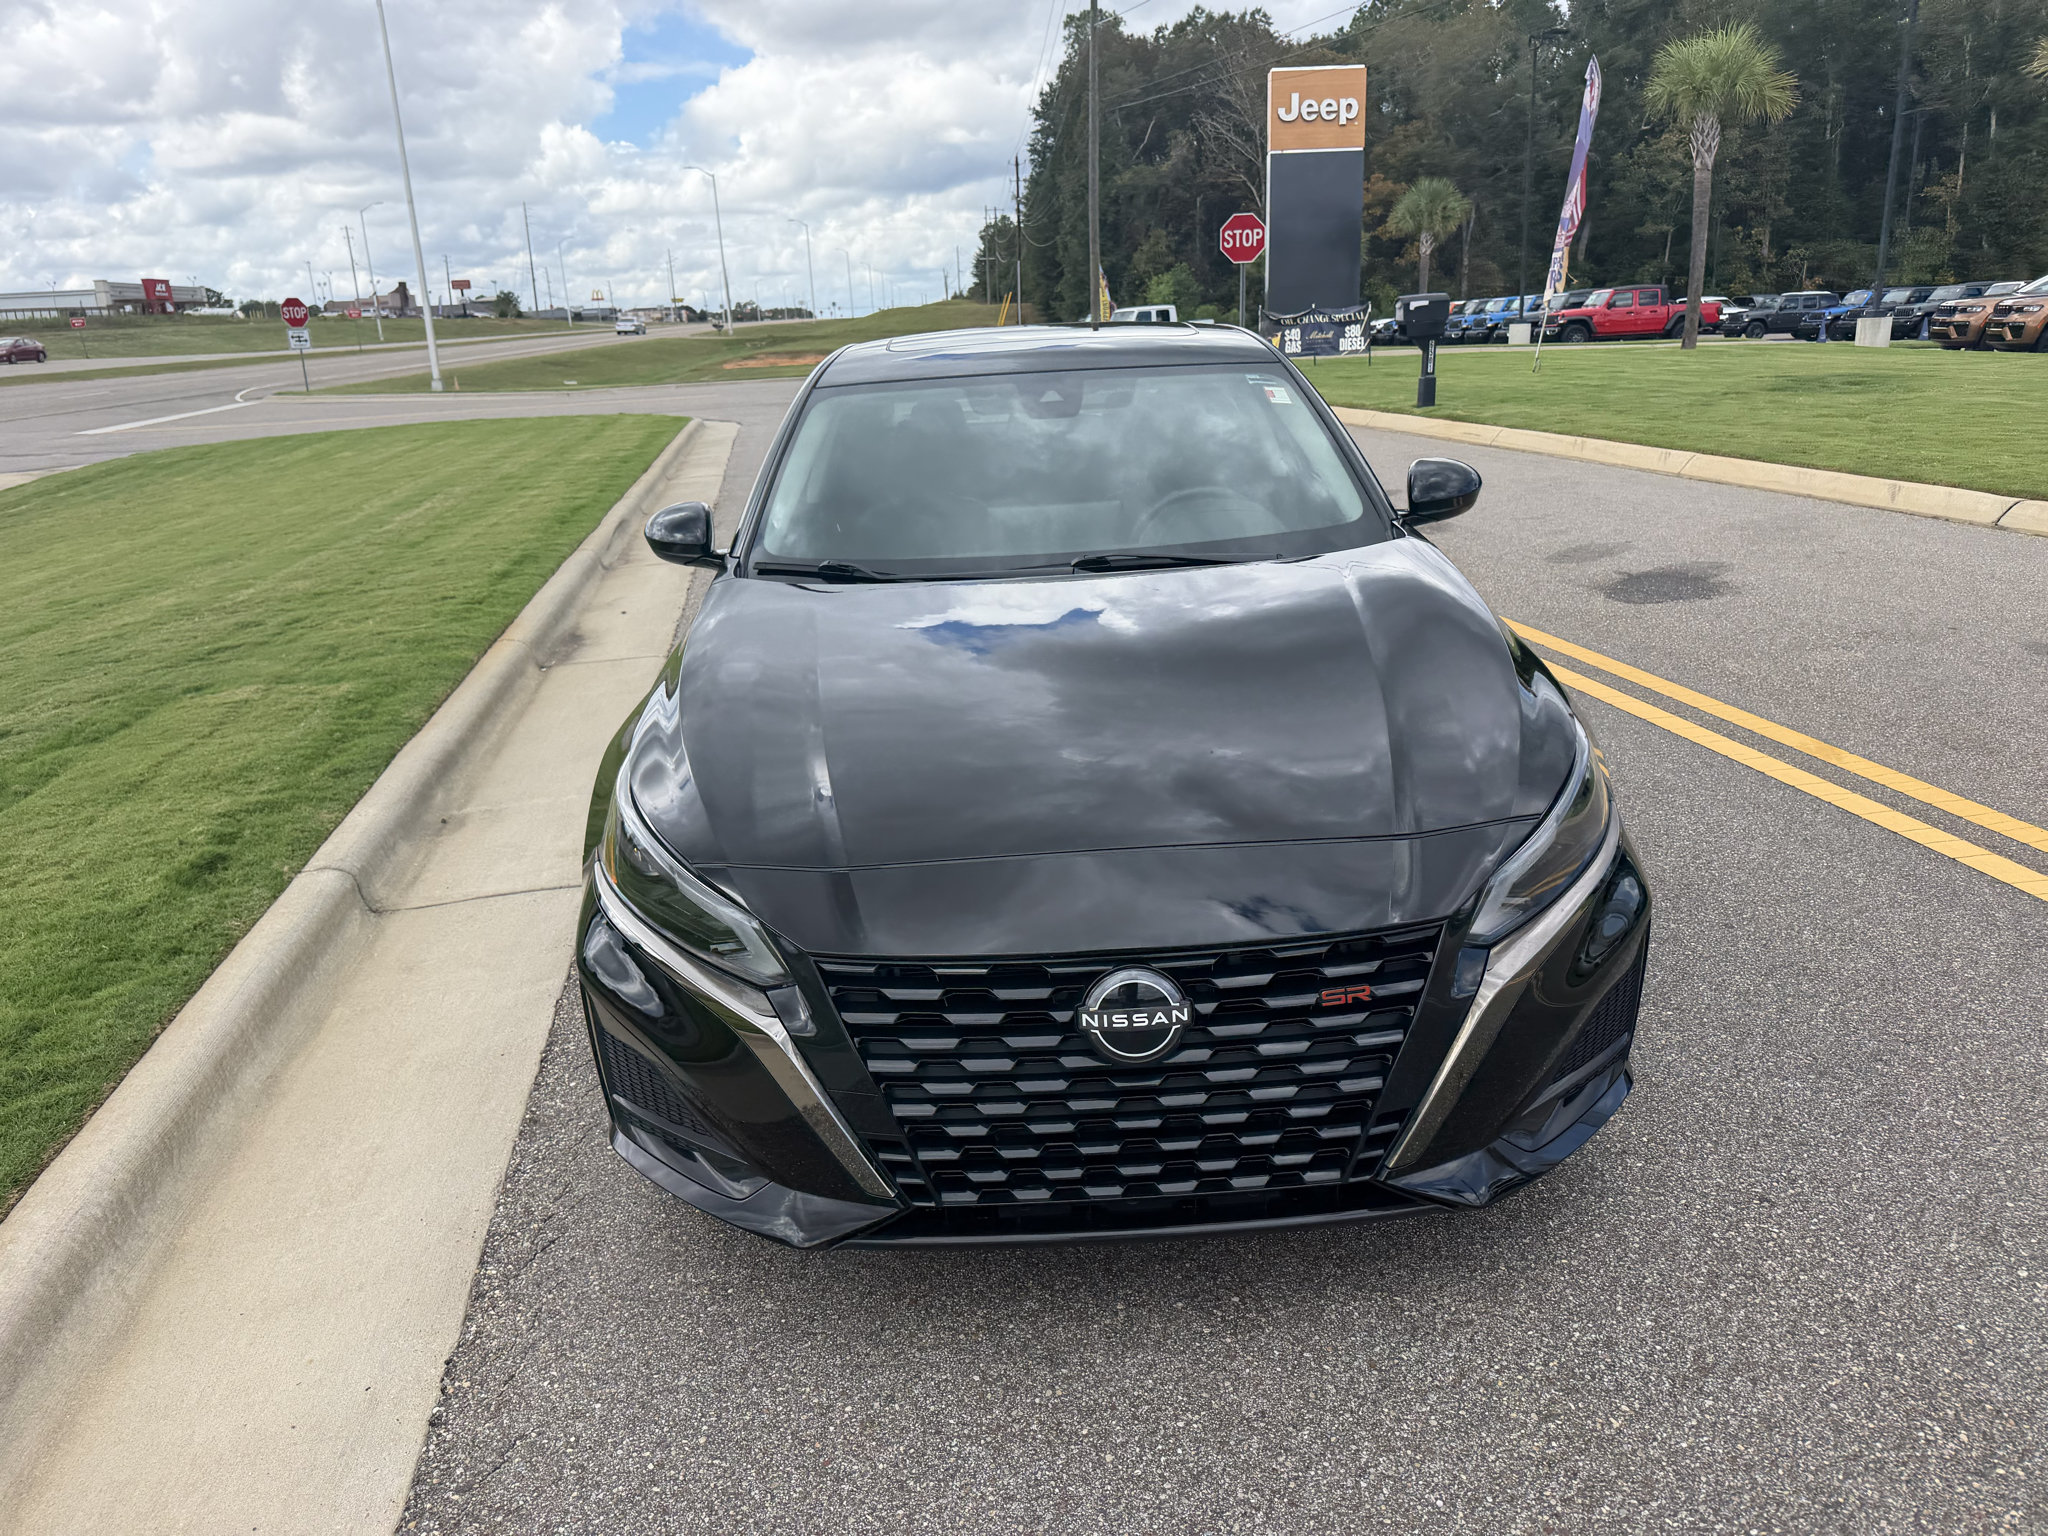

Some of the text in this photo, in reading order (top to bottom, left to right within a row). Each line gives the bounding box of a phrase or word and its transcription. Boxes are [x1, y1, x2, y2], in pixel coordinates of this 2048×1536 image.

[1277, 92, 1359, 126] Jeep
[1223, 228, 1263, 248] STOP
[282, 306, 307, 319] STOP
[1297, 314, 1330, 324] CHANGE
[1331, 311, 1365, 321] SPECIAL
[1284, 328, 1301, 341] $40
[1344, 324, 1361, 338] $80
[1285, 340, 1302, 353] GAS
[1339, 337, 1365, 351] DIESEL
[1321, 985, 1371, 1007] SR
[1081, 1007, 1188, 1028] NISSAN
